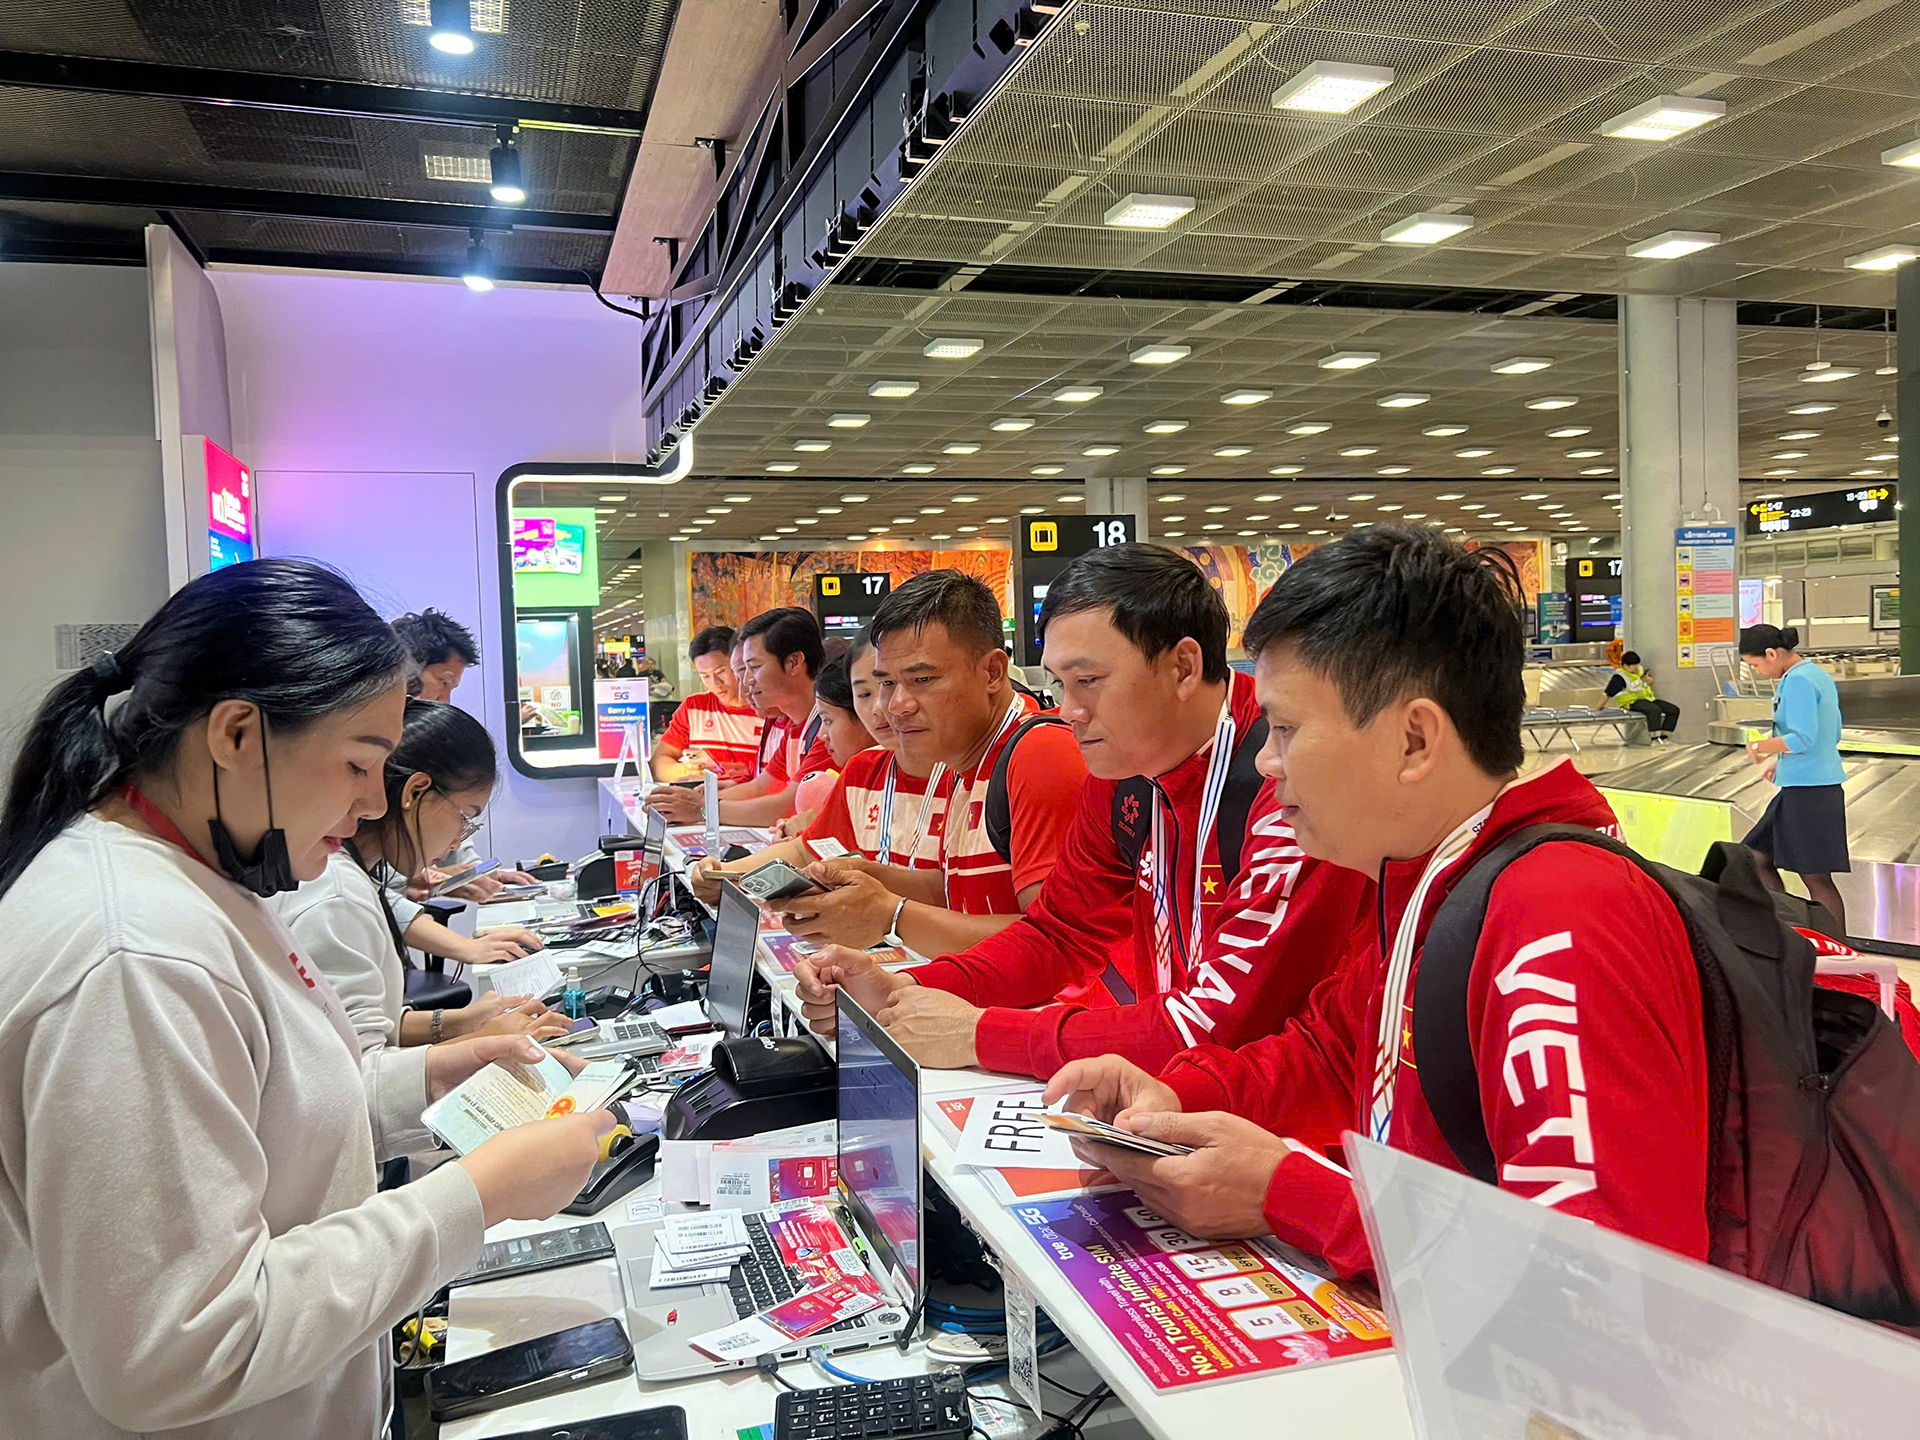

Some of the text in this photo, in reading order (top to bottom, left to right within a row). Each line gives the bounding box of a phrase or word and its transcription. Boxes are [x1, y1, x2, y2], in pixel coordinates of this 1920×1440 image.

[1092, 520, 1127, 548] 18
[1607, 560, 1623, 576] 17
[862, 576, 885, 595] 17
[614, 692, 629, 700] 5G
[607, 706, 636, 715] Sorry for
[984, 1099, 1048, 1153] FREE
[1134, 1207, 1164, 1222] 60
[1015, 1205, 1077, 1260] true dtac 5G
[1157, 1230, 1190, 1247] 30
[1125, 1260, 1143, 1272] 100
[1185, 1256, 1217, 1273] 15
[1233, 1255, 1254, 1267] 699
[1095, 1276, 1116, 1290] with
[1134, 1270, 1153, 1283] Free
[1145, 1284, 1169, 1300] WiFi
[1215, 1285, 1243, 1297] 8
[1240, 1281, 1259, 1295] days
[1263, 1282, 1285, 1295] 499
[1104, 1289, 1131, 1308] Travel
[1084, 1243, 1219, 1375] No.1 Tourist Infinite SIM
[1152, 1260, 1261, 1364] Available in both physical SIM and eSIM
[1161, 1299, 1187, 1318] Calls
[1328, 1303, 1354, 1321] Free
[1121, 1306, 1159, 1339] Seamless
[1246, 1315, 1275, 1328] 5
[1274, 1311, 1293, 1325] days
[1297, 1312, 1321, 1326] 399
[1180, 1318, 1203, 1335] Data
[1147, 1336, 1192, 1377] Connected
[1193, 1333, 1236, 1369] Unlimited
